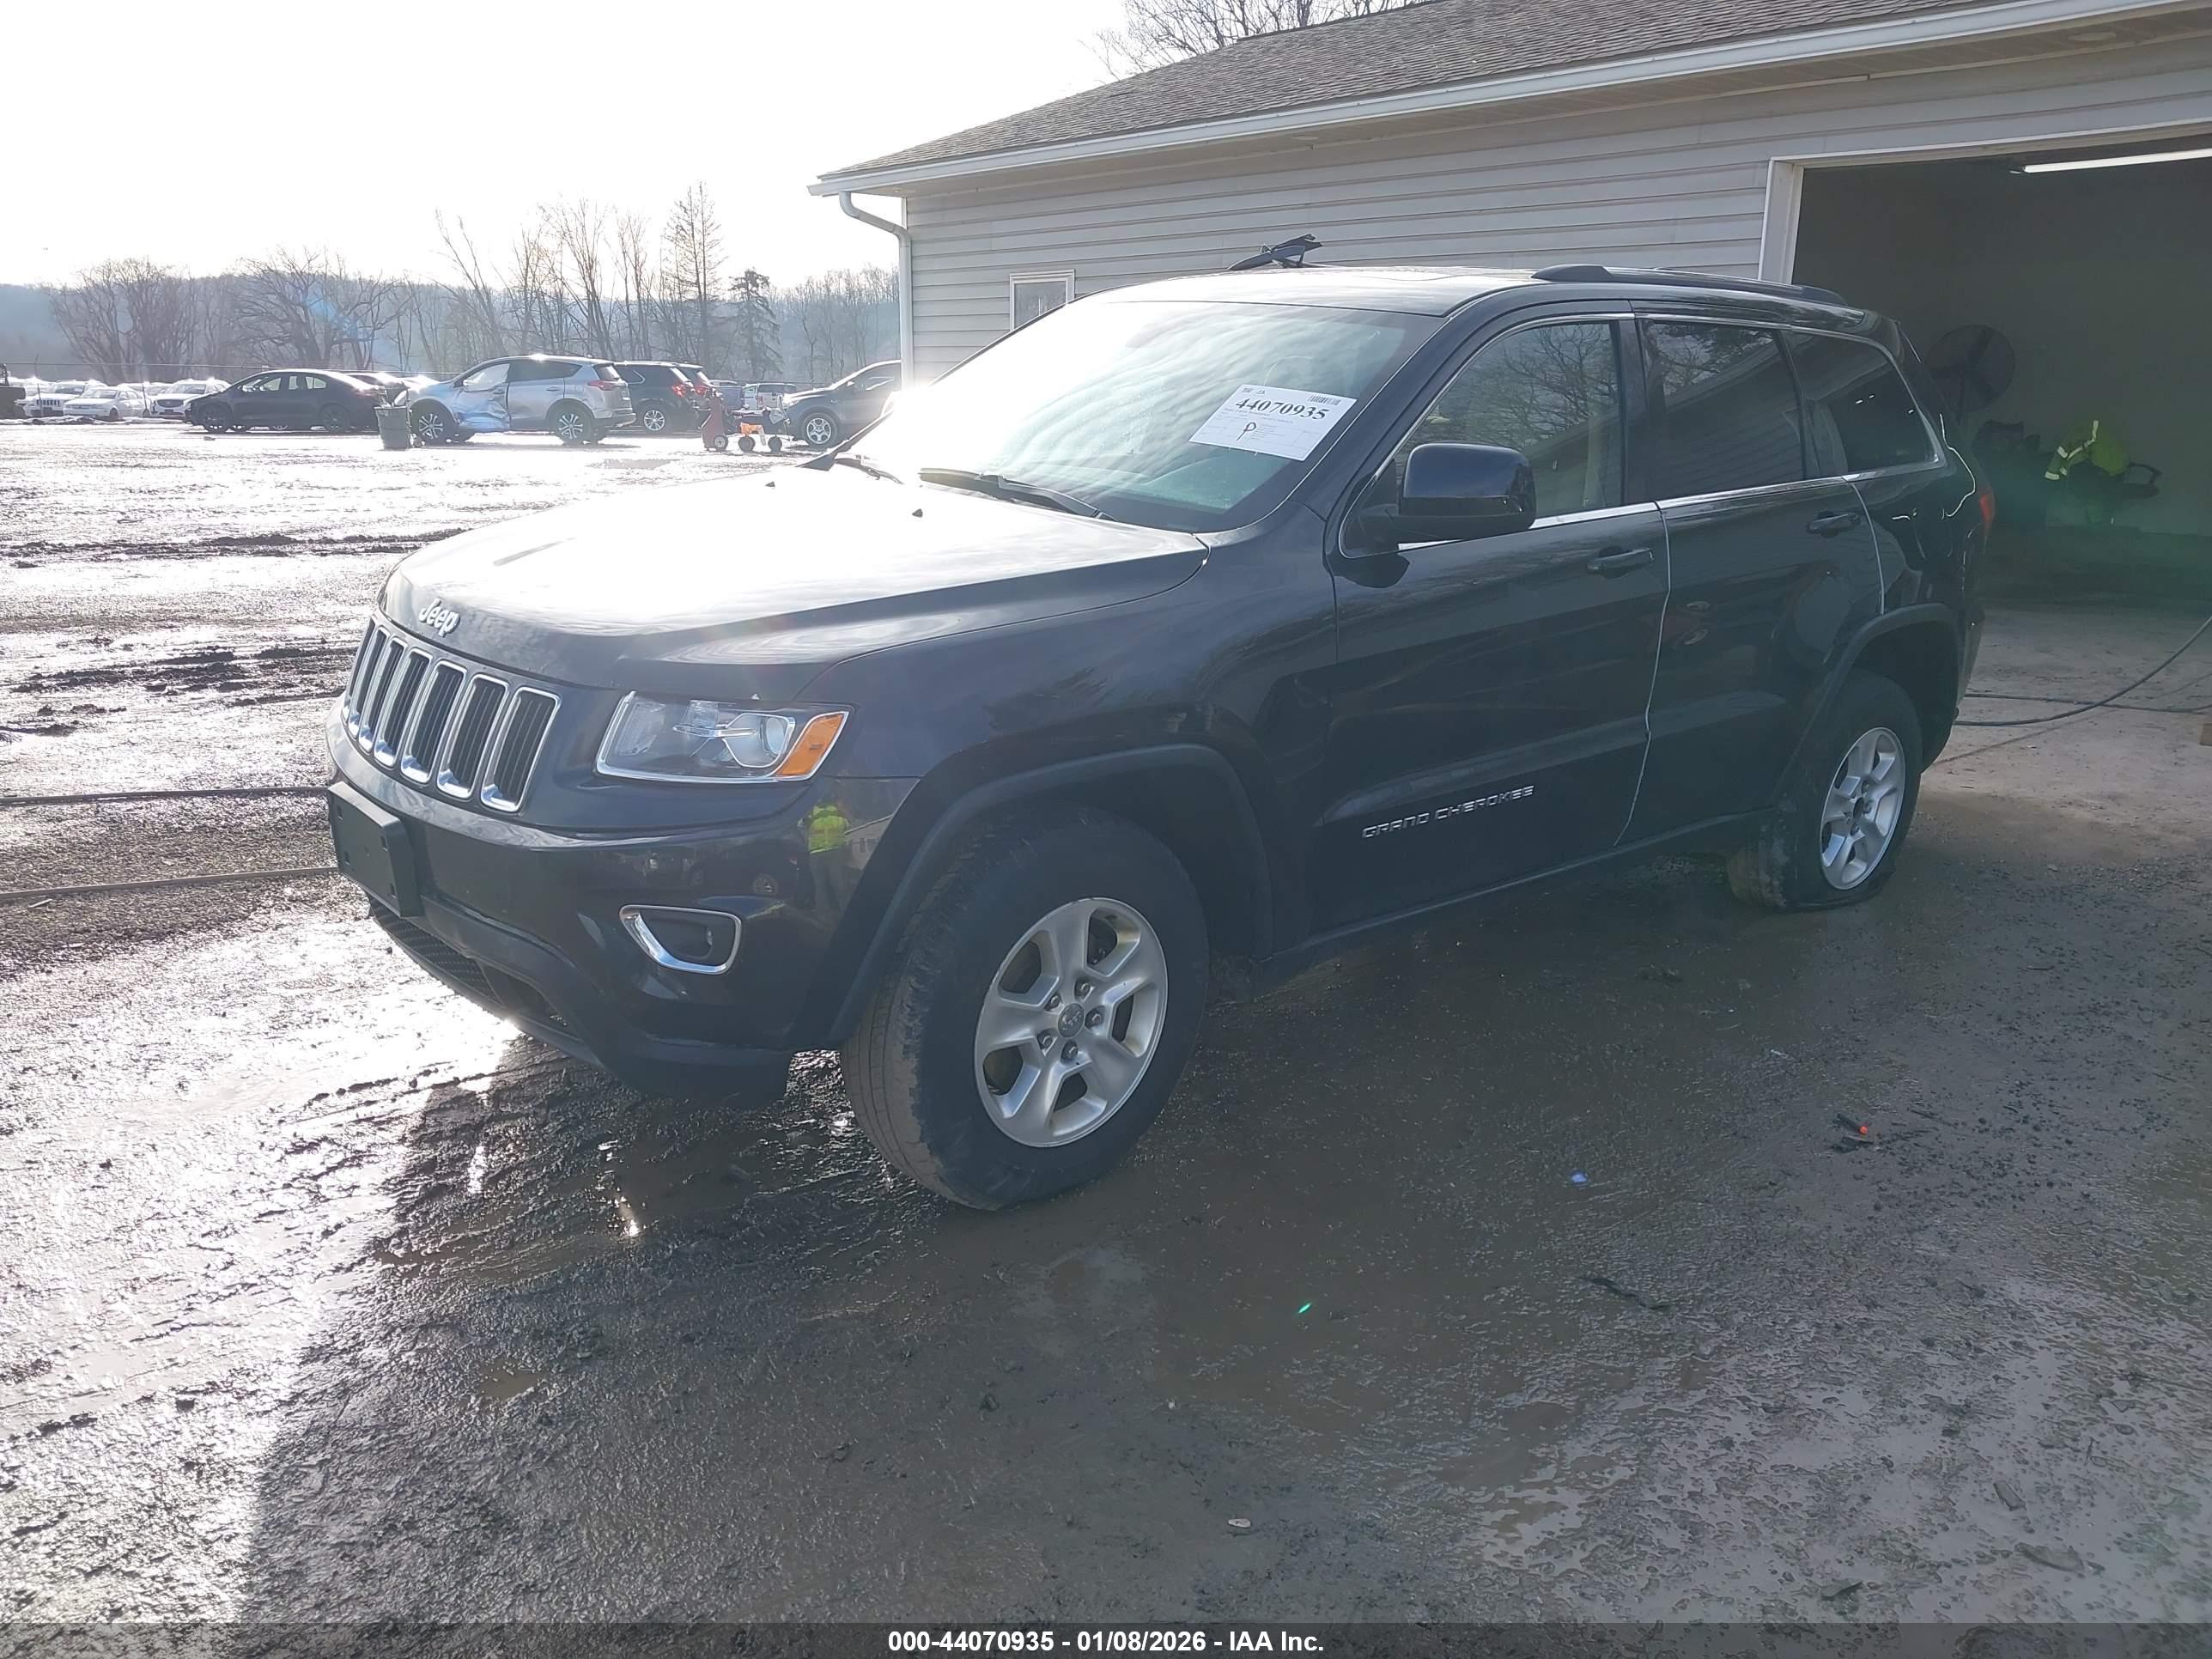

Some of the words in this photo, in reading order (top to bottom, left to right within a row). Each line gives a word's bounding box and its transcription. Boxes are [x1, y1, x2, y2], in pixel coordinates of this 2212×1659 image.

[1235, 398, 1329, 420] 44070935
[419, 599, 460, 637] Jeep
[1362, 813, 1430, 838] GRAND
[1435, 785, 1534, 819] CHEROKEE
